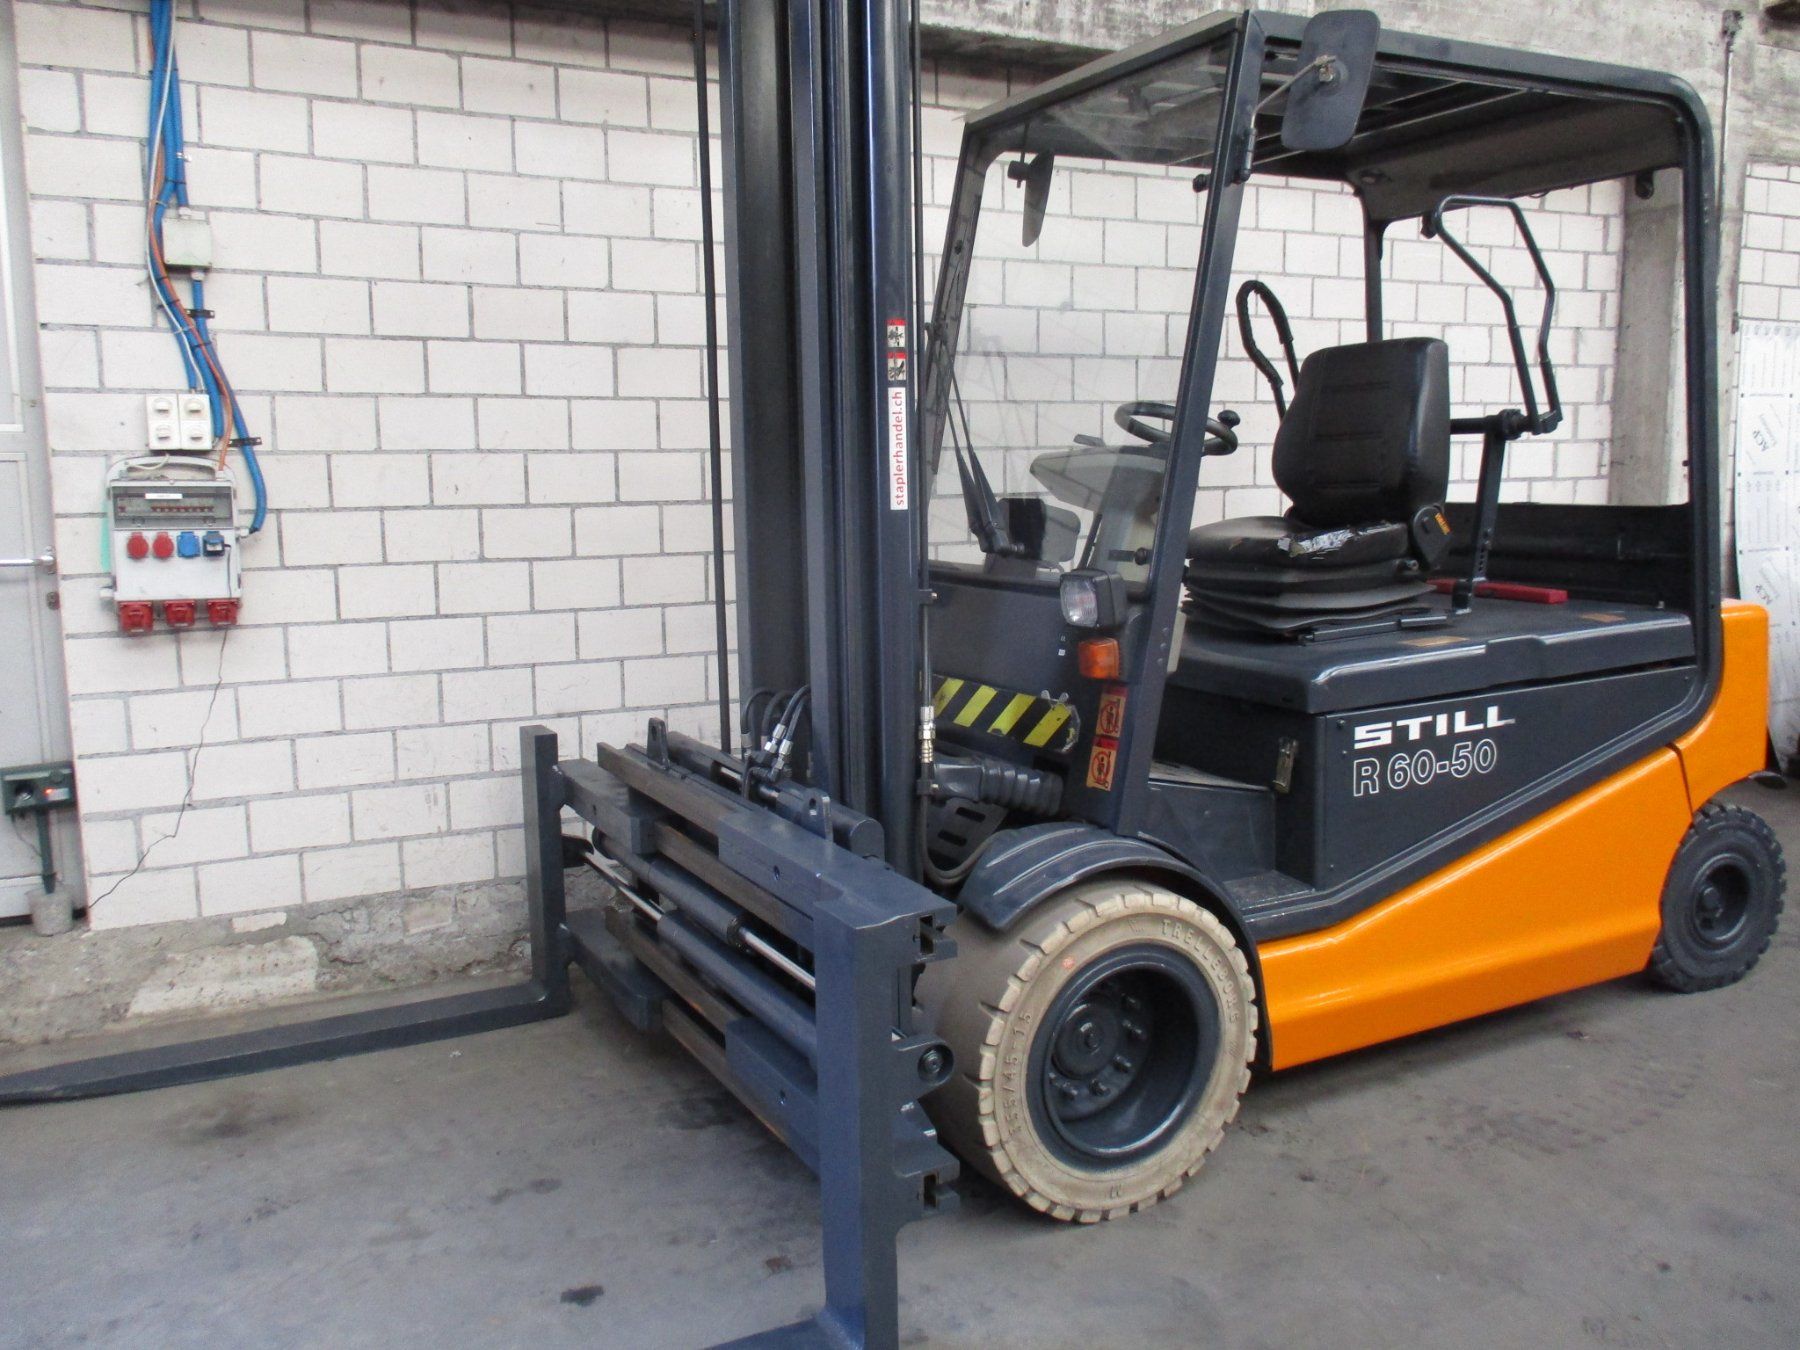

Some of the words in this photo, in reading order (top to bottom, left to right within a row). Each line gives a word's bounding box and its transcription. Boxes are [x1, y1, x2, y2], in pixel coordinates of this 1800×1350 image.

[892, 391, 905, 506] staplerhandel.ch
[1354, 705, 1516, 750] STILL
[1353, 757, 1380, 797] R
[1387, 738, 1497, 790] 60-50
